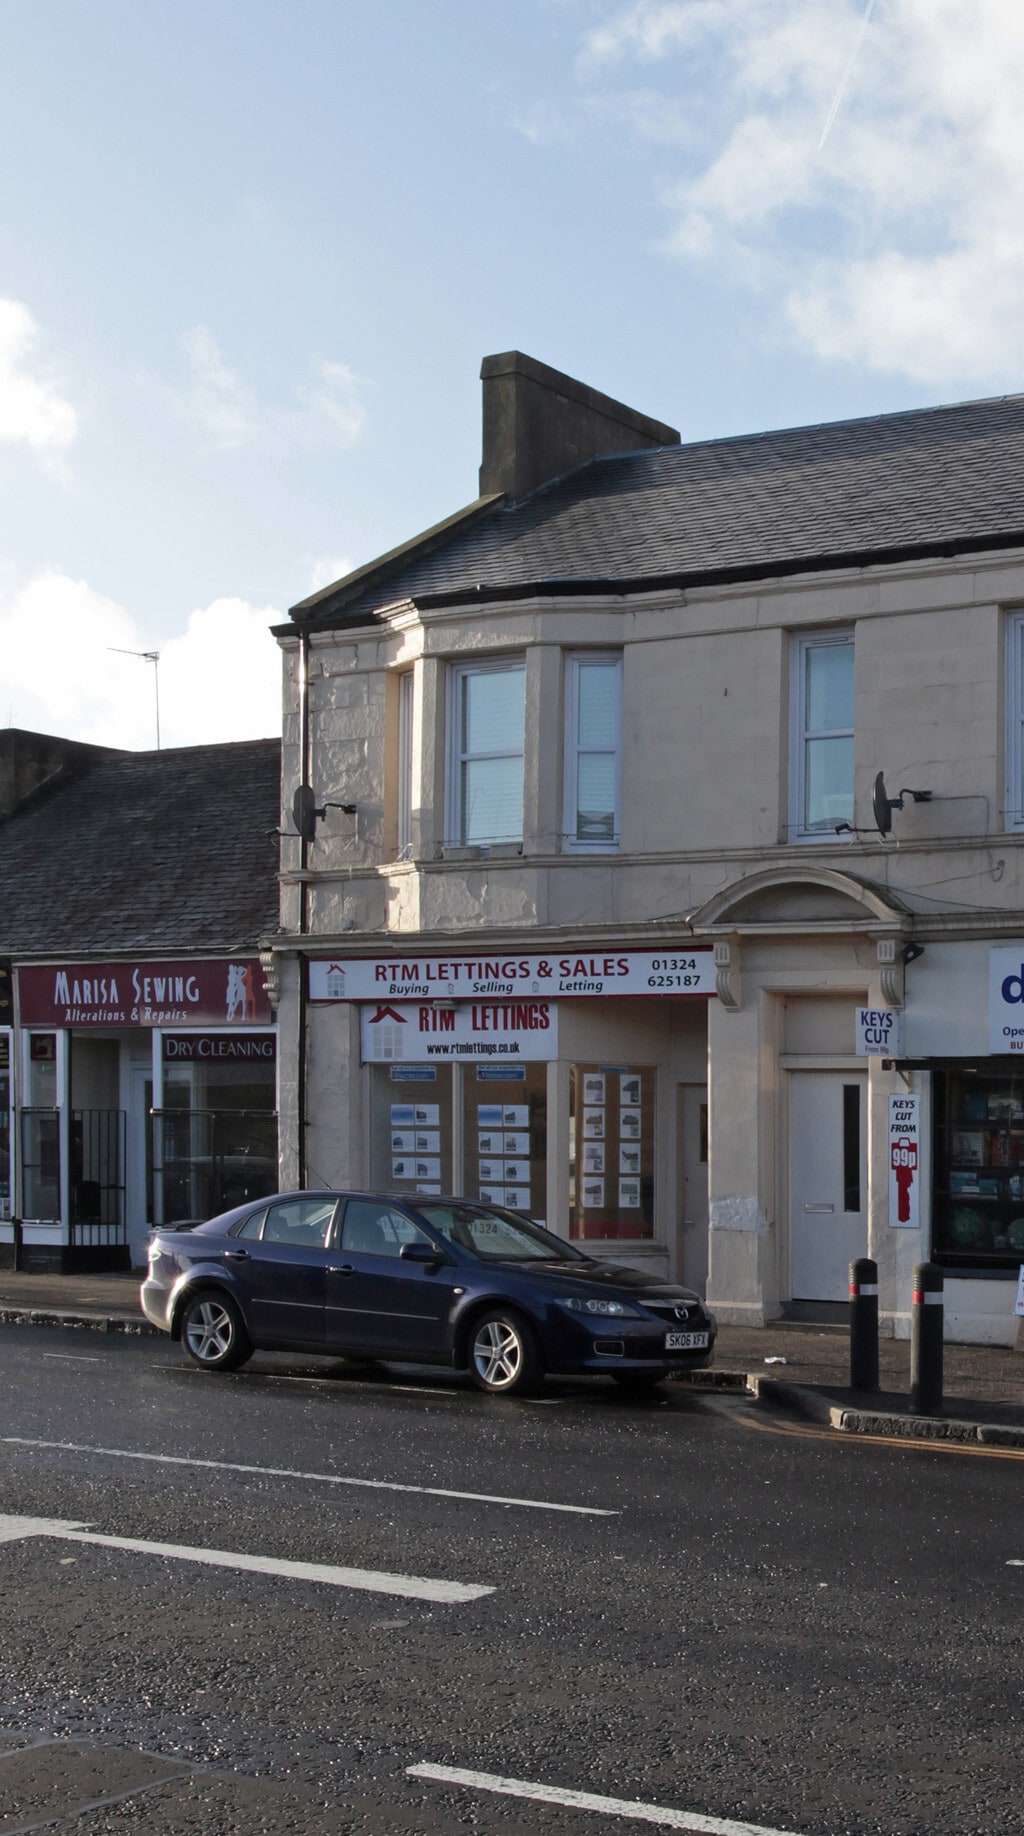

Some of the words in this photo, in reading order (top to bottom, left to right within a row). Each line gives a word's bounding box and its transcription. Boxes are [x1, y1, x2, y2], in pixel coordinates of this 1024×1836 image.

[375, 963, 419, 981] RTM
[426, 960, 531, 981] LETTINGS
[537, 960, 553, 978] &
[559, 957, 630, 977] SALES
[652, 958, 697, 971] 01324
[389, 983, 429, 996] Buying
[472, 981, 514, 995] Selling
[558, 979, 603, 993] Letting
[647, 974, 701, 987] 625187
[65, 1008, 125, 1021] Alterations
[130, 1008, 139, 1021] &
[144, 1007, 188, 1024] Repairs
[419, 1004, 455, 1032] RTM
[471, 1003, 550, 1031] LETTINGS
[861, 1010, 893, 1028] KEYS
[864, 1028, 890, 1044] CUT
[166, 1039, 196, 1056] DRY
[198, 1038, 273, 1057] CLEANING
[427, 1040, 520, 1055] www.rtmlettings.co.uk
[880, 1046, 889, 1054] 99p
[893, 1100, 915, 1109] KEYS
[895, 1112, 912, 1121] CUT
[891, 1124, 916, 1133] FROM
[892, 1148, 916, 1168] 99p
[669, 1335, 691, 1346] SK06
[692, 1334, 706, 1345] XFX
